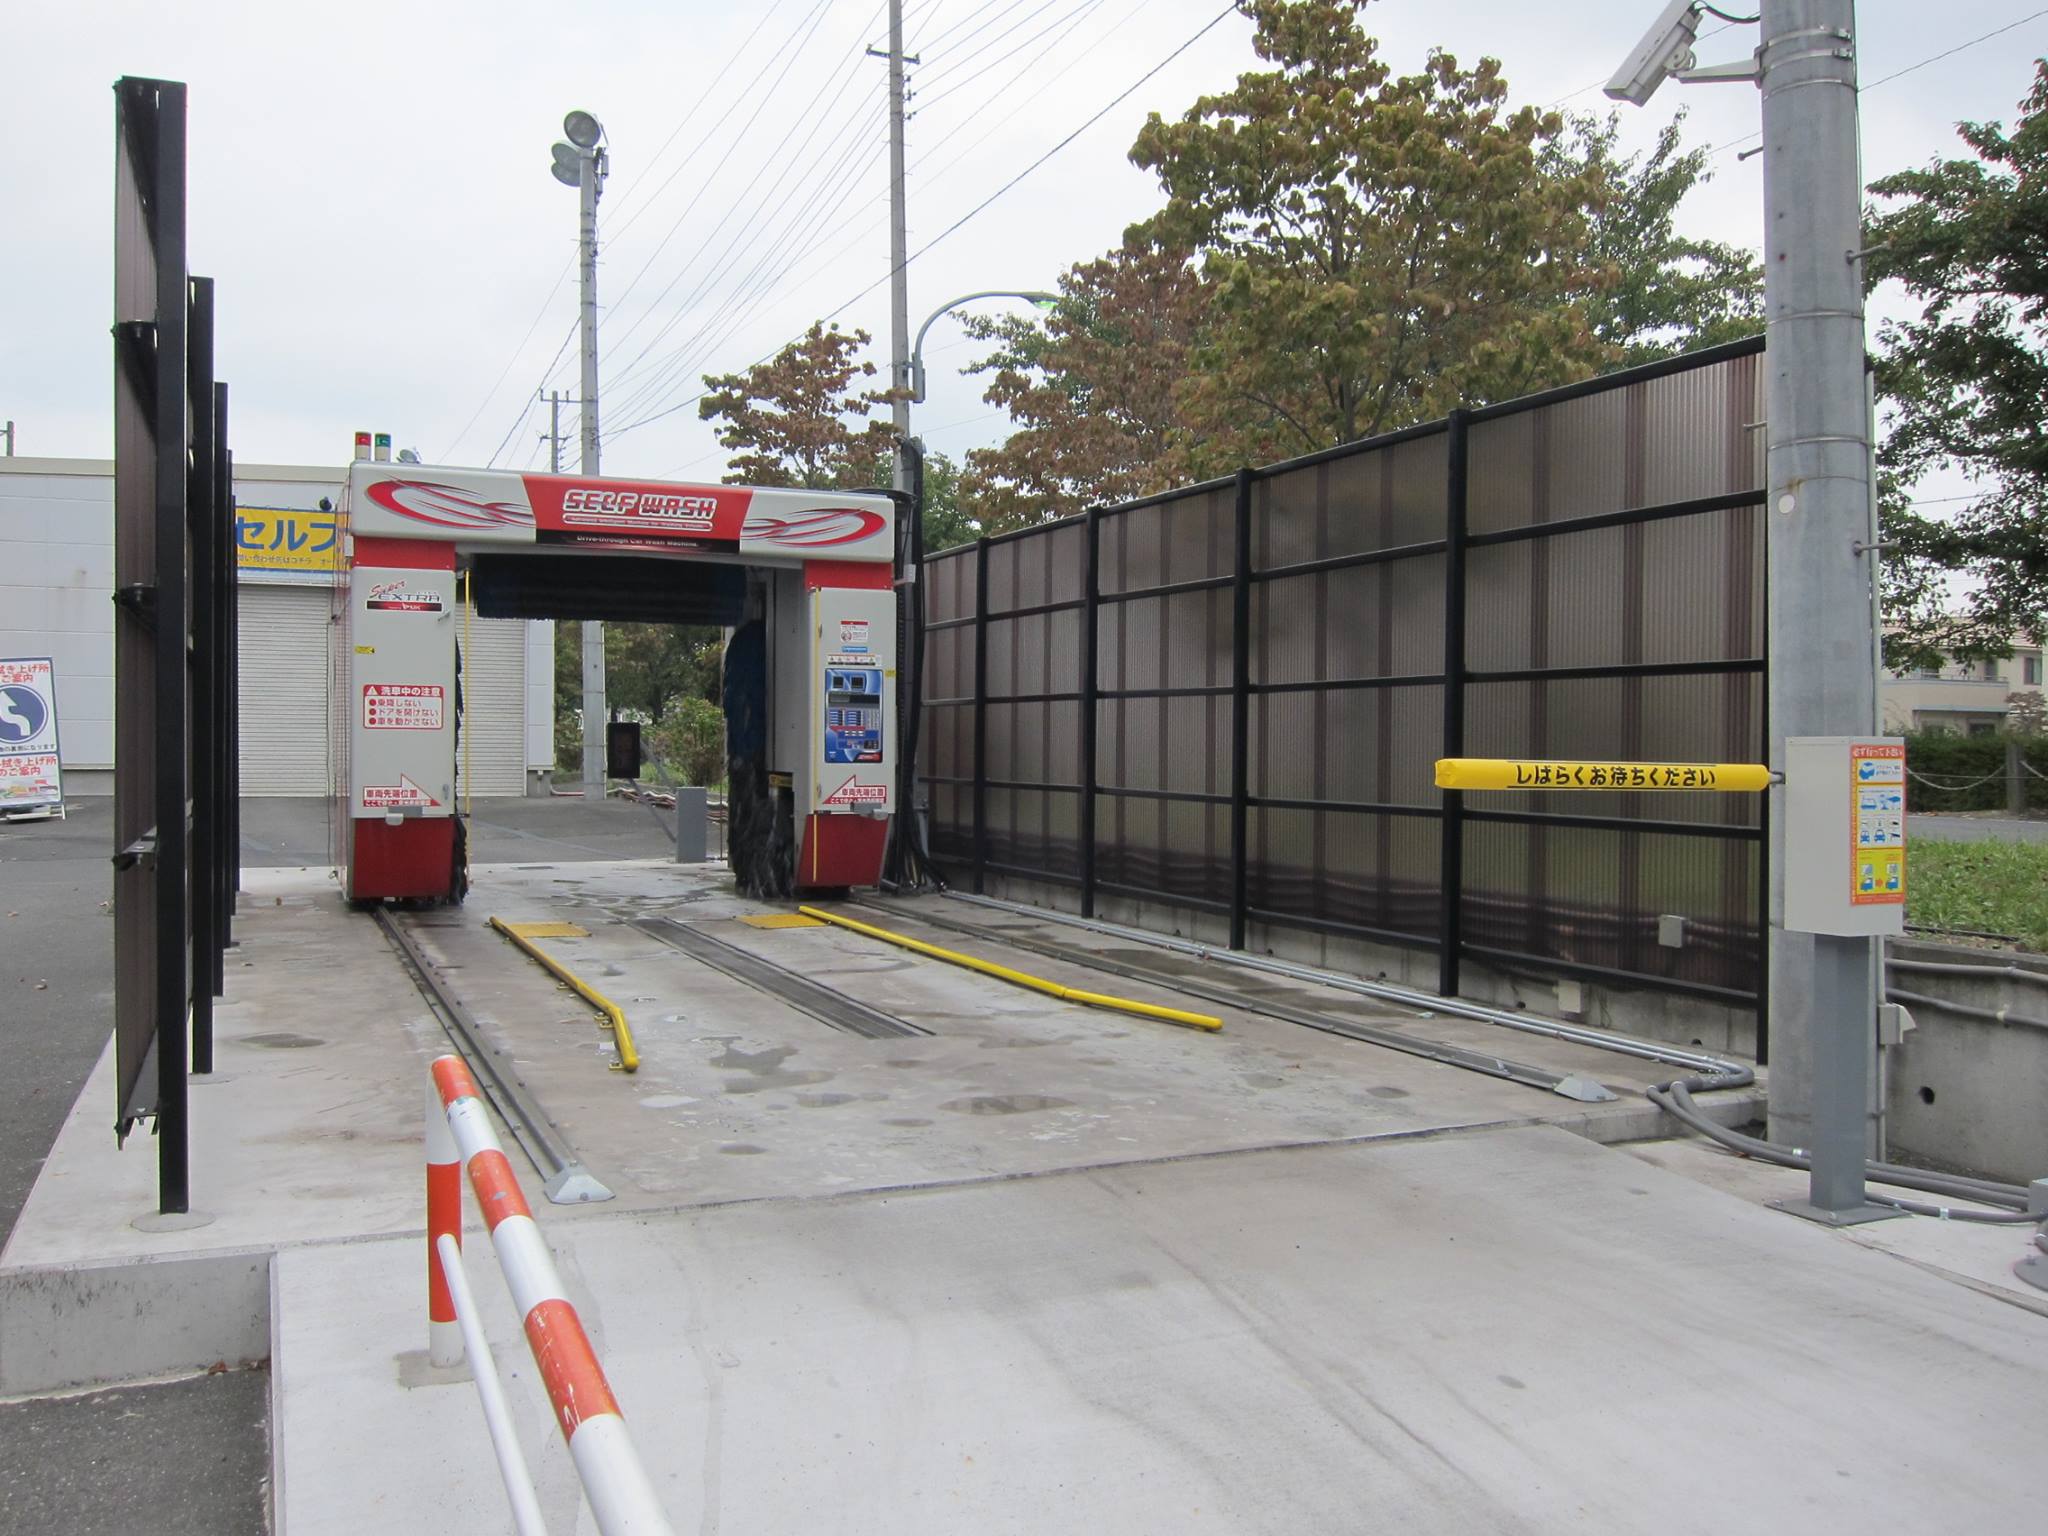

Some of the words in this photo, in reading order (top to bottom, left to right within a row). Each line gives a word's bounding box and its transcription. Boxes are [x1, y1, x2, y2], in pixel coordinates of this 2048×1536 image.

[562, 489, 639, 515] SELF
[639, 493, 718, 520] WASH
[237, 516, 336, 552] セルフ
[378, 593, 440, 602] EXTRA
[381, 686, 440, 696] 洗車中の注意
[378, 708, 439, 717] ドアを開けない
[378, 717, 439, 726] 車を動かさない
[1516, 765, 1715, 786] しばらくお待ちください
